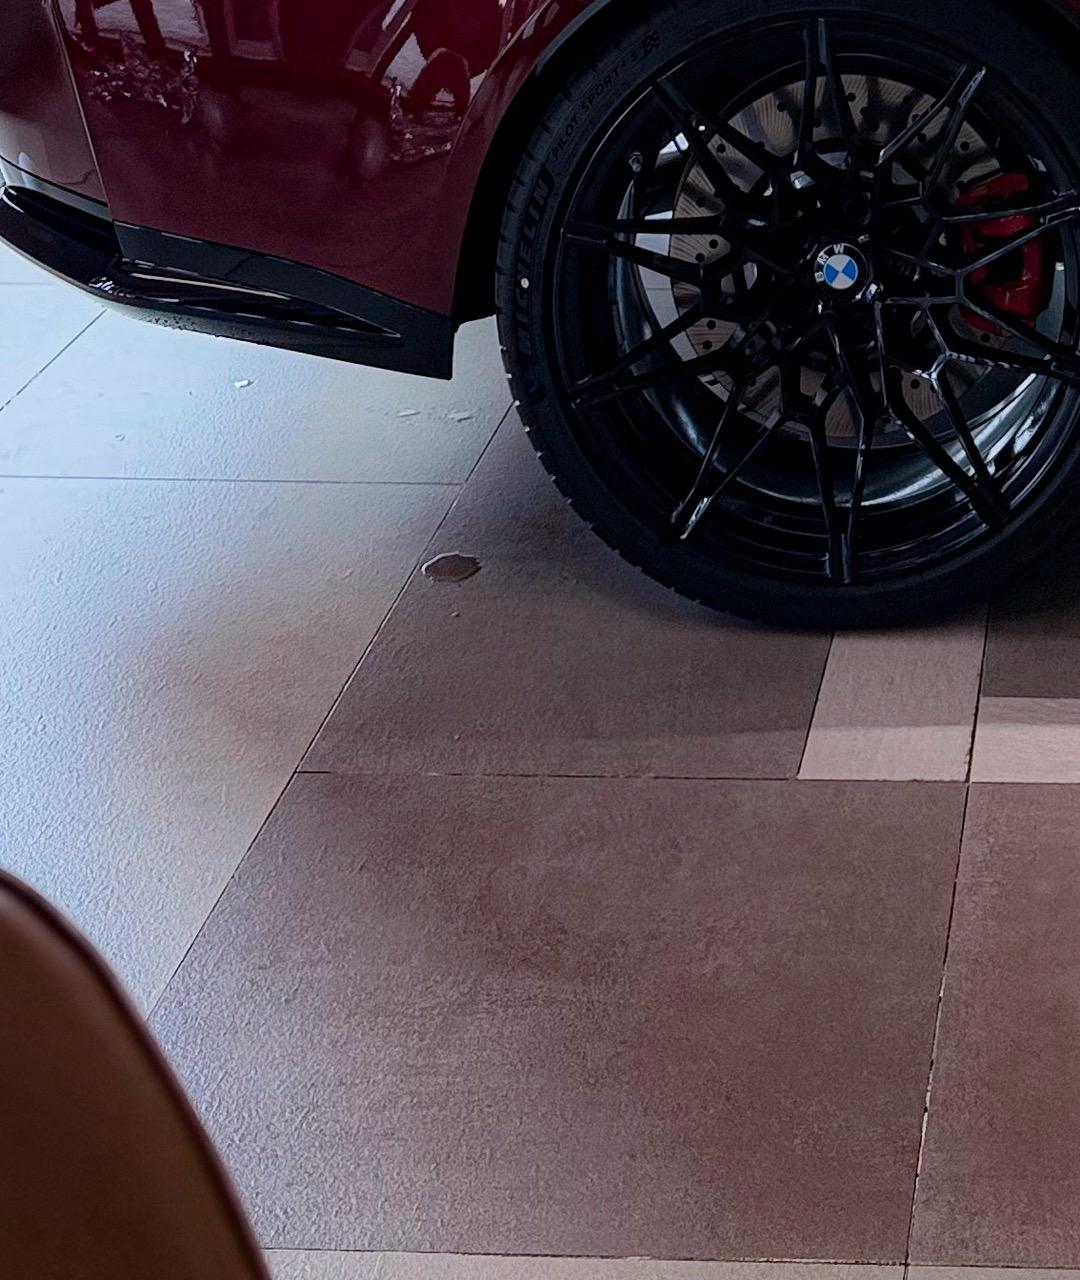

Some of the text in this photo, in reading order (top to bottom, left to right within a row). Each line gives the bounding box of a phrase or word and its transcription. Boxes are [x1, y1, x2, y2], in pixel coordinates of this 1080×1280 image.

[551, 65, 619, 159] PILOT SPORT
[814, 243, 845, 282] BMW
